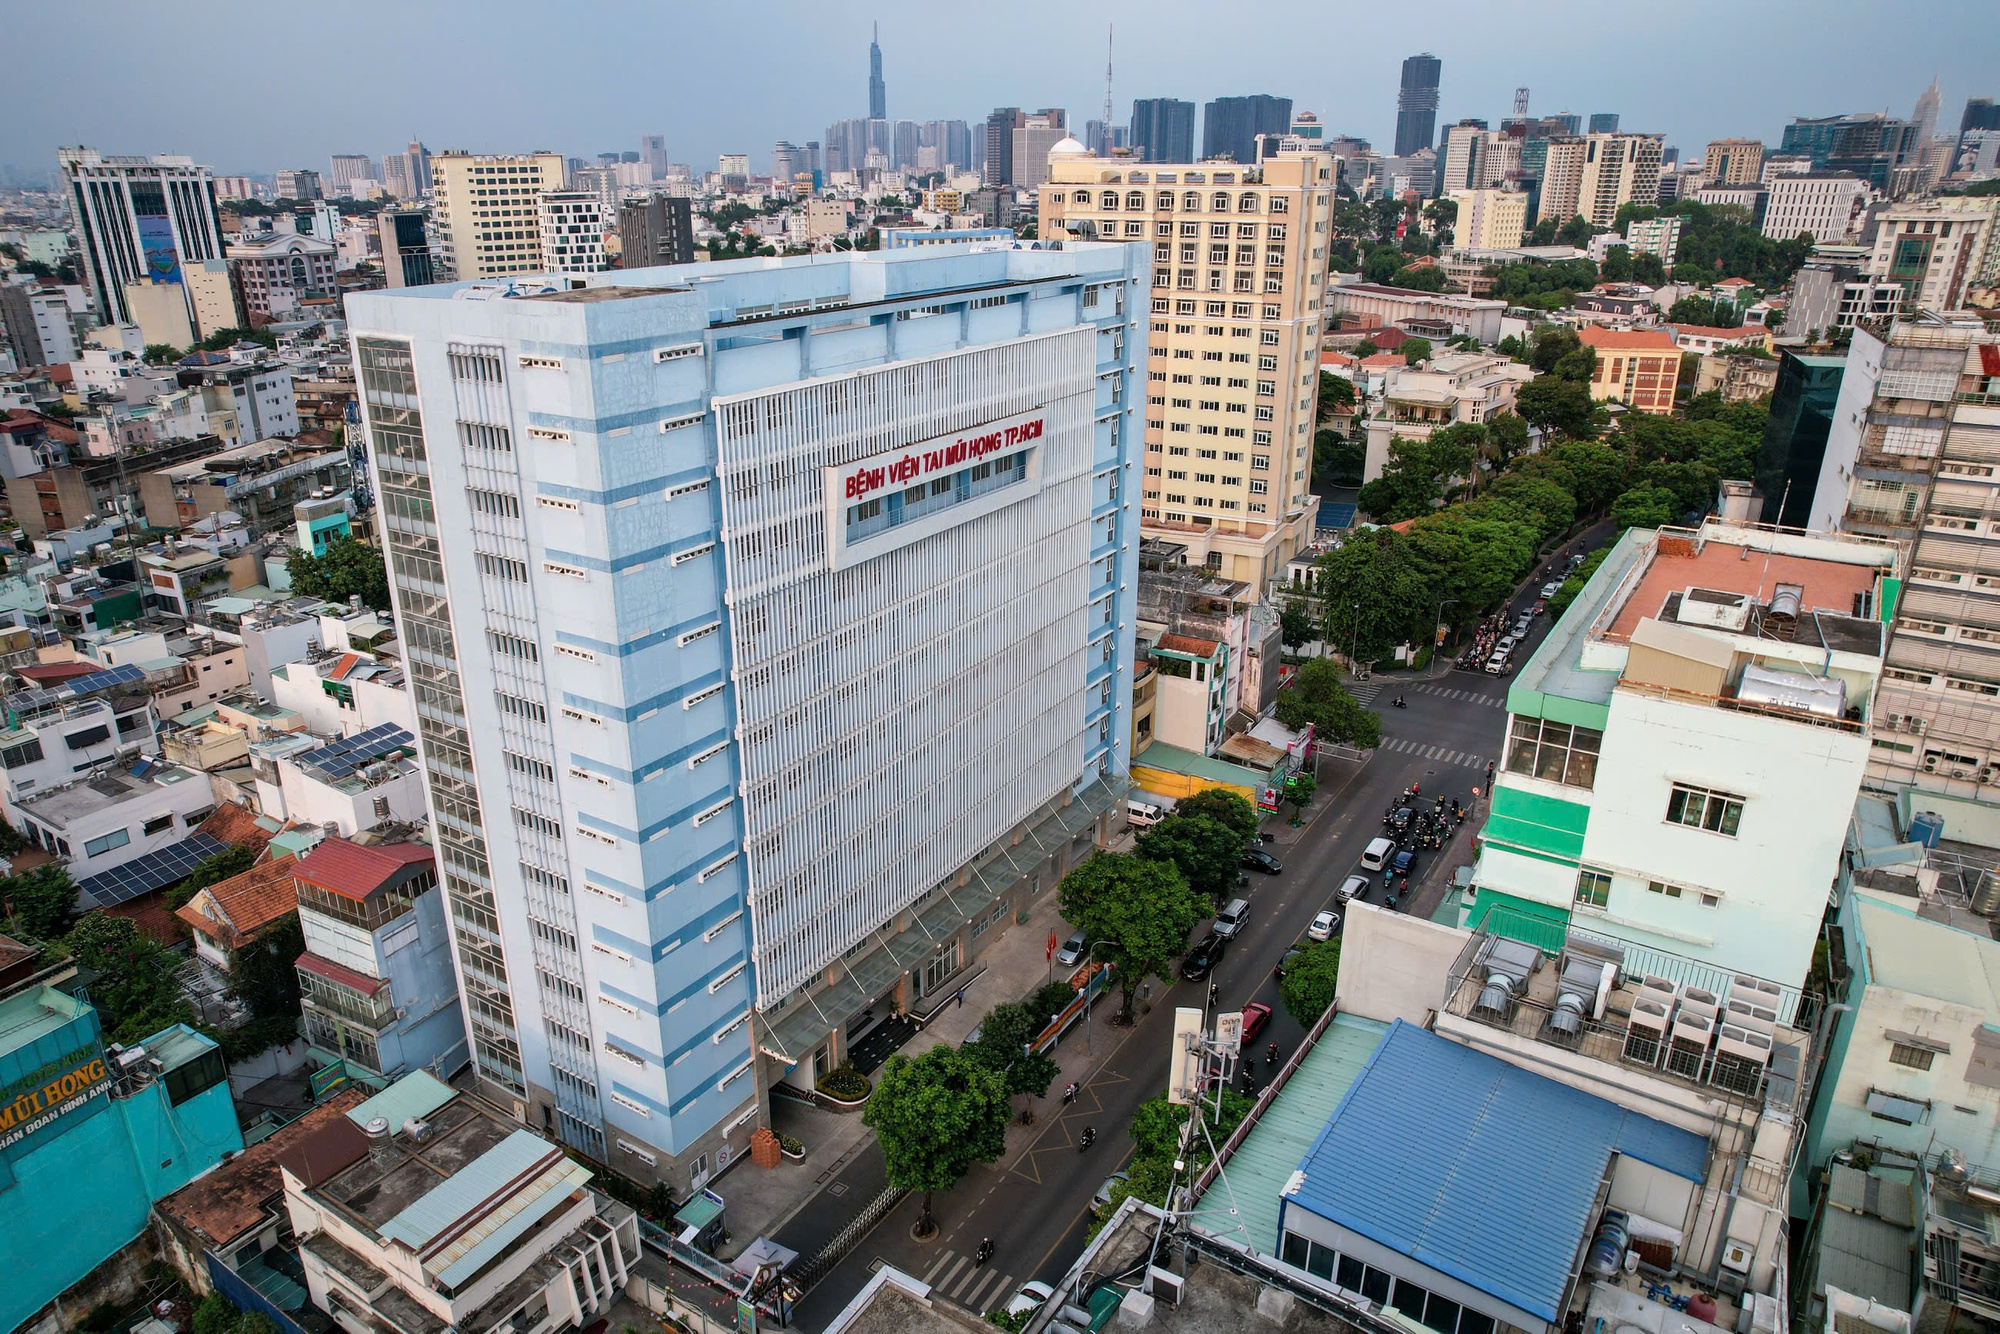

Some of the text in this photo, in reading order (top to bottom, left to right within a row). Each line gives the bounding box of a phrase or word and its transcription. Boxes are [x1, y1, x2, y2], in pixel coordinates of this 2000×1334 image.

[846, 419, 1043, 500] BỆNH VIỆN TAI MŨI HỌNG TP.HCM
[43, 1058, 106, 1106] HỌNG
[60, 1093, 88, 1115] HÌNH
